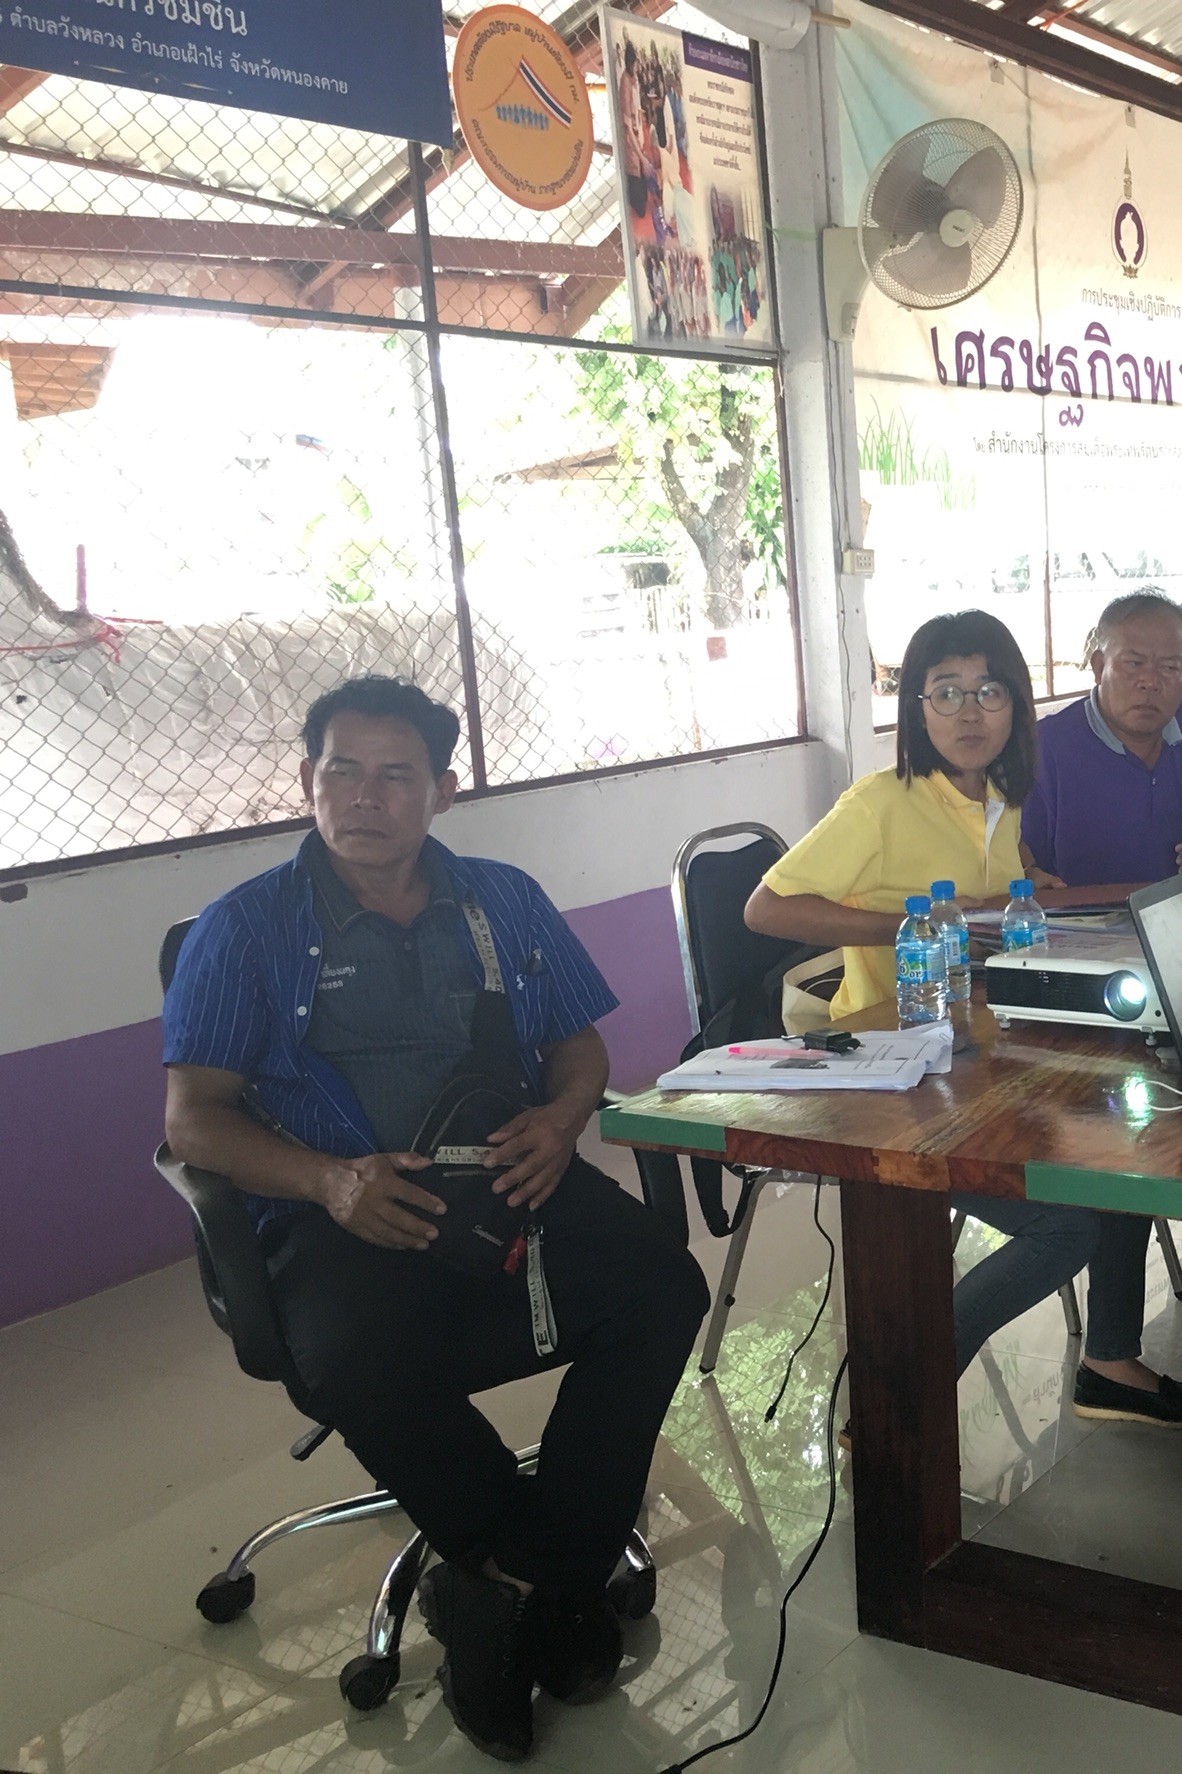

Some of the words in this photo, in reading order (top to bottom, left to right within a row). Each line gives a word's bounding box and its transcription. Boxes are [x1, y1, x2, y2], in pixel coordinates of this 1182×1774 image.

[11, 6, 124, 50] ตำบลวังหลวง
[131, 32, 223, 70] อำเภอเฝ้าไร่
[230, 54, 349, 95] จังหวัดหนองคาย
[1081, 287, 1182, 321] การประชุมเชิงปฏิบัติการ
